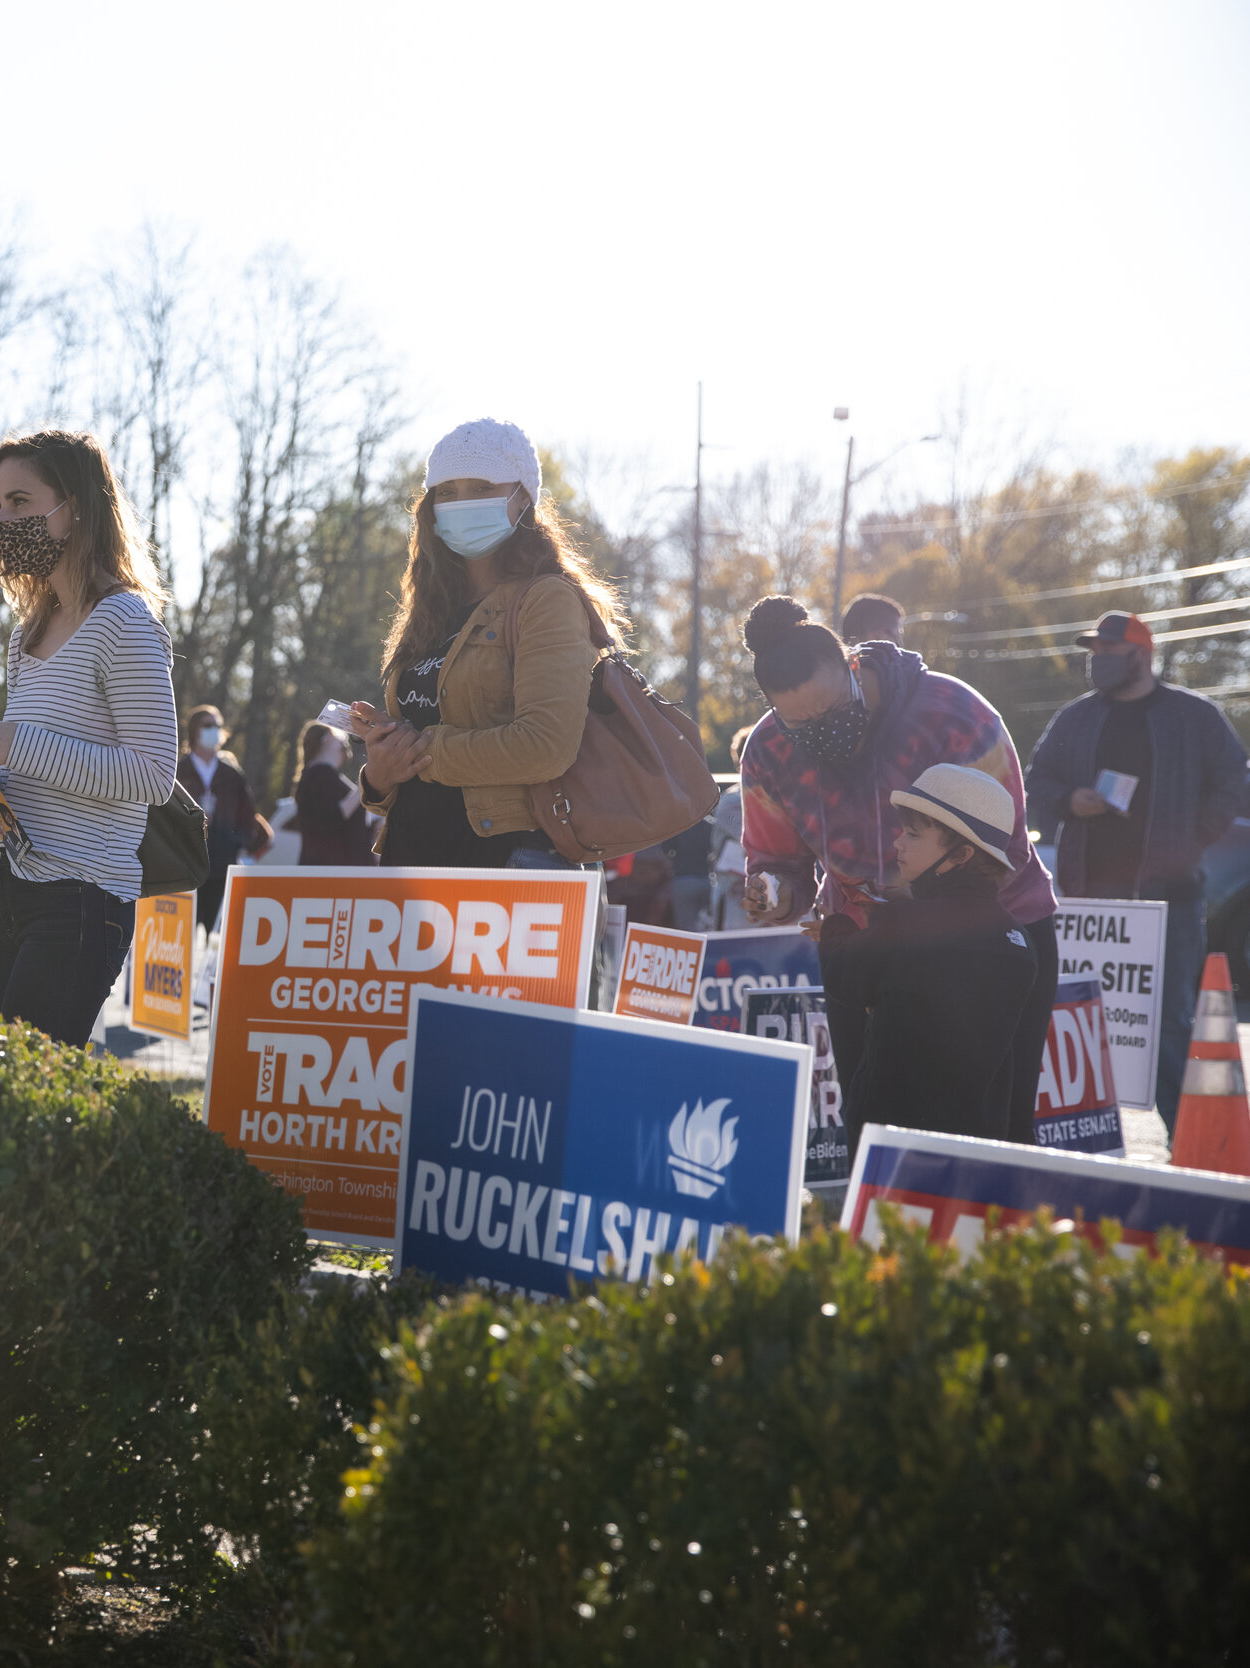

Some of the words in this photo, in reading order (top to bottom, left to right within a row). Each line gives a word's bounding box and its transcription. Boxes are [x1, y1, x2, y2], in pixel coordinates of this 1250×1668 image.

[238, 897, 564, 979] DEIRDRE
[332, 909, 349, 961] VOTE
[1053, 913, 1131, 943] FFICIAL
[144, 962, 183, 999] MYERS
[271, 976, 405, 1014] GEORGE
[1101, 961, 1153, 994] SITE
[261, 1044, 275, 1096] VOTE
[1035, 1004, 1106, 1112] ADY
[239, 1109, 348, 1151] HORTH
[450, 1085, 552, 1165] JOHN
[1038, 1119, 1077, 1146] STATE
[1077, 1111, 1119, 1139] SENATE
[338, 1176, 398, 1199] Townshi
